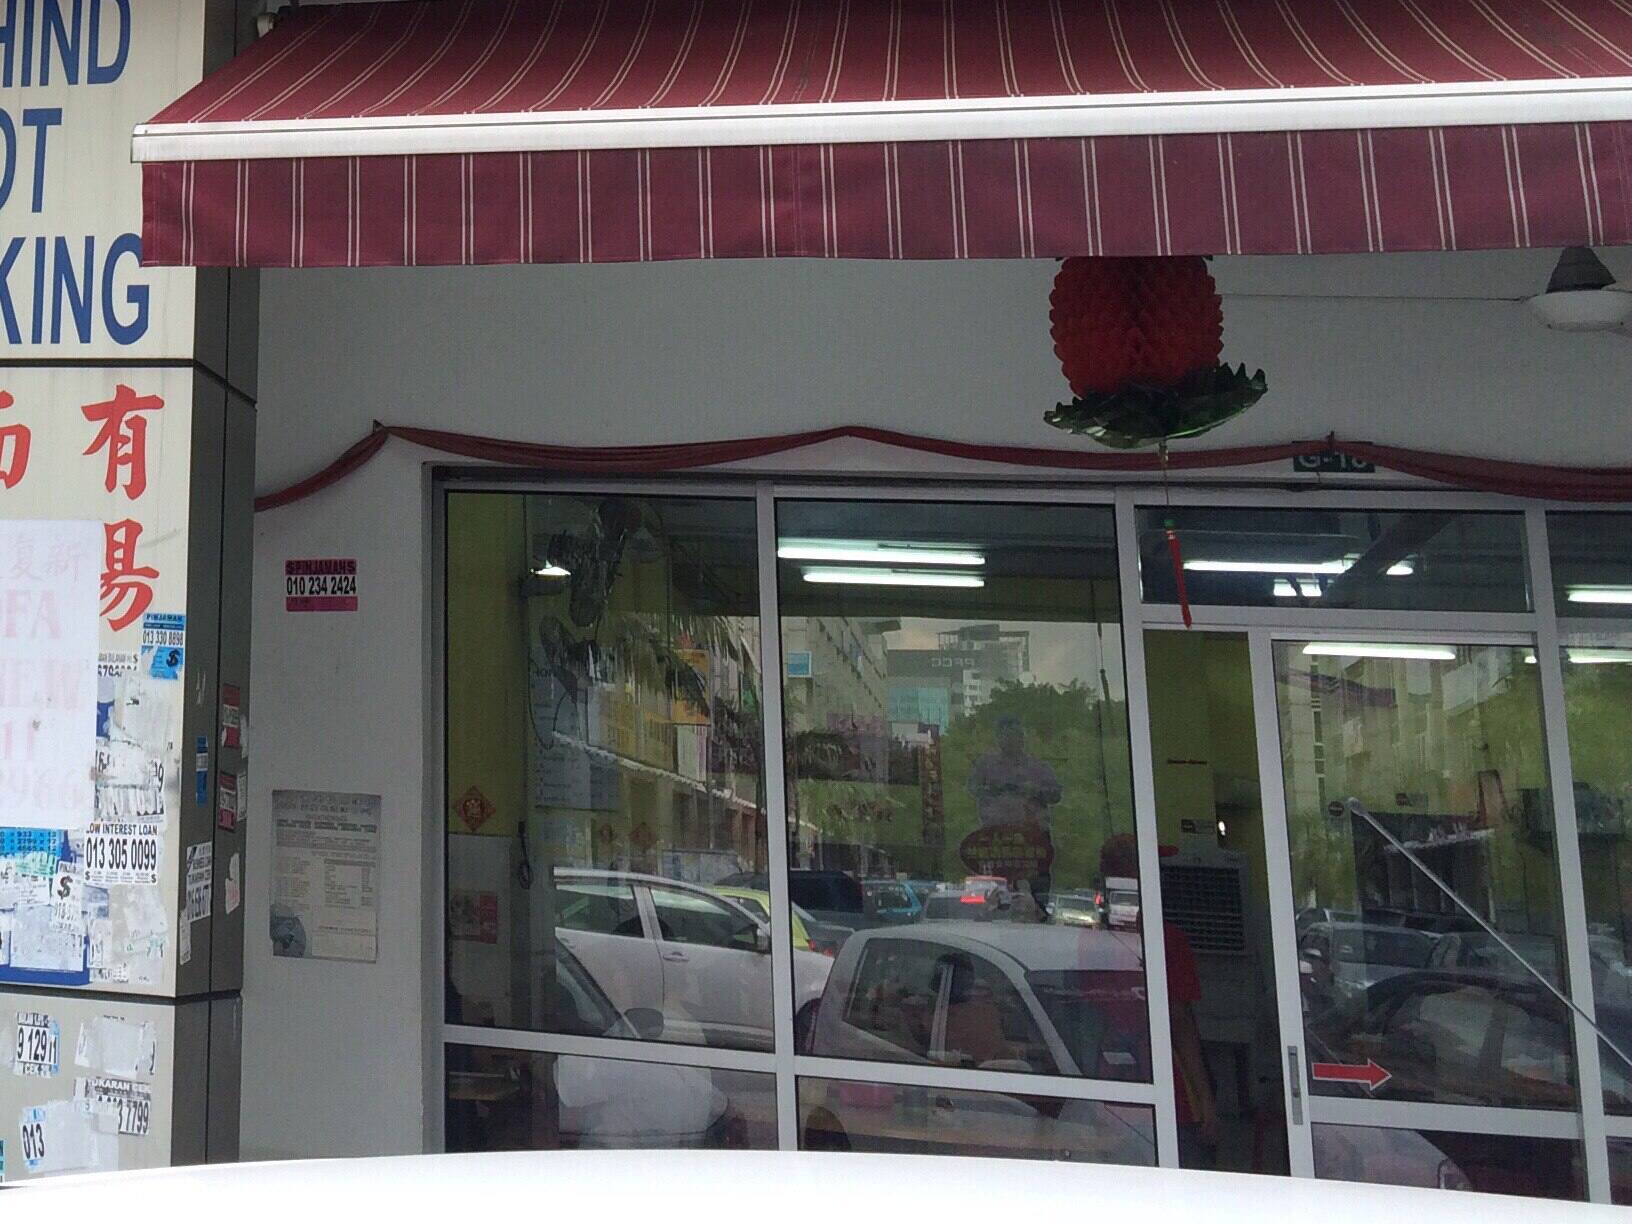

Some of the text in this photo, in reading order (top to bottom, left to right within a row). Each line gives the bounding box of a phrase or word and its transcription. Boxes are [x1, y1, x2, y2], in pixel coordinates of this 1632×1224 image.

[287, 576, 356, 595] 010 234 2424
[103, 823, 136, 834] INTEREST
[138, 824, 158, 836] LOAN
[86, 837, 157, 870] 013 305 0099
[23, 1123, 45, 1160] 013
